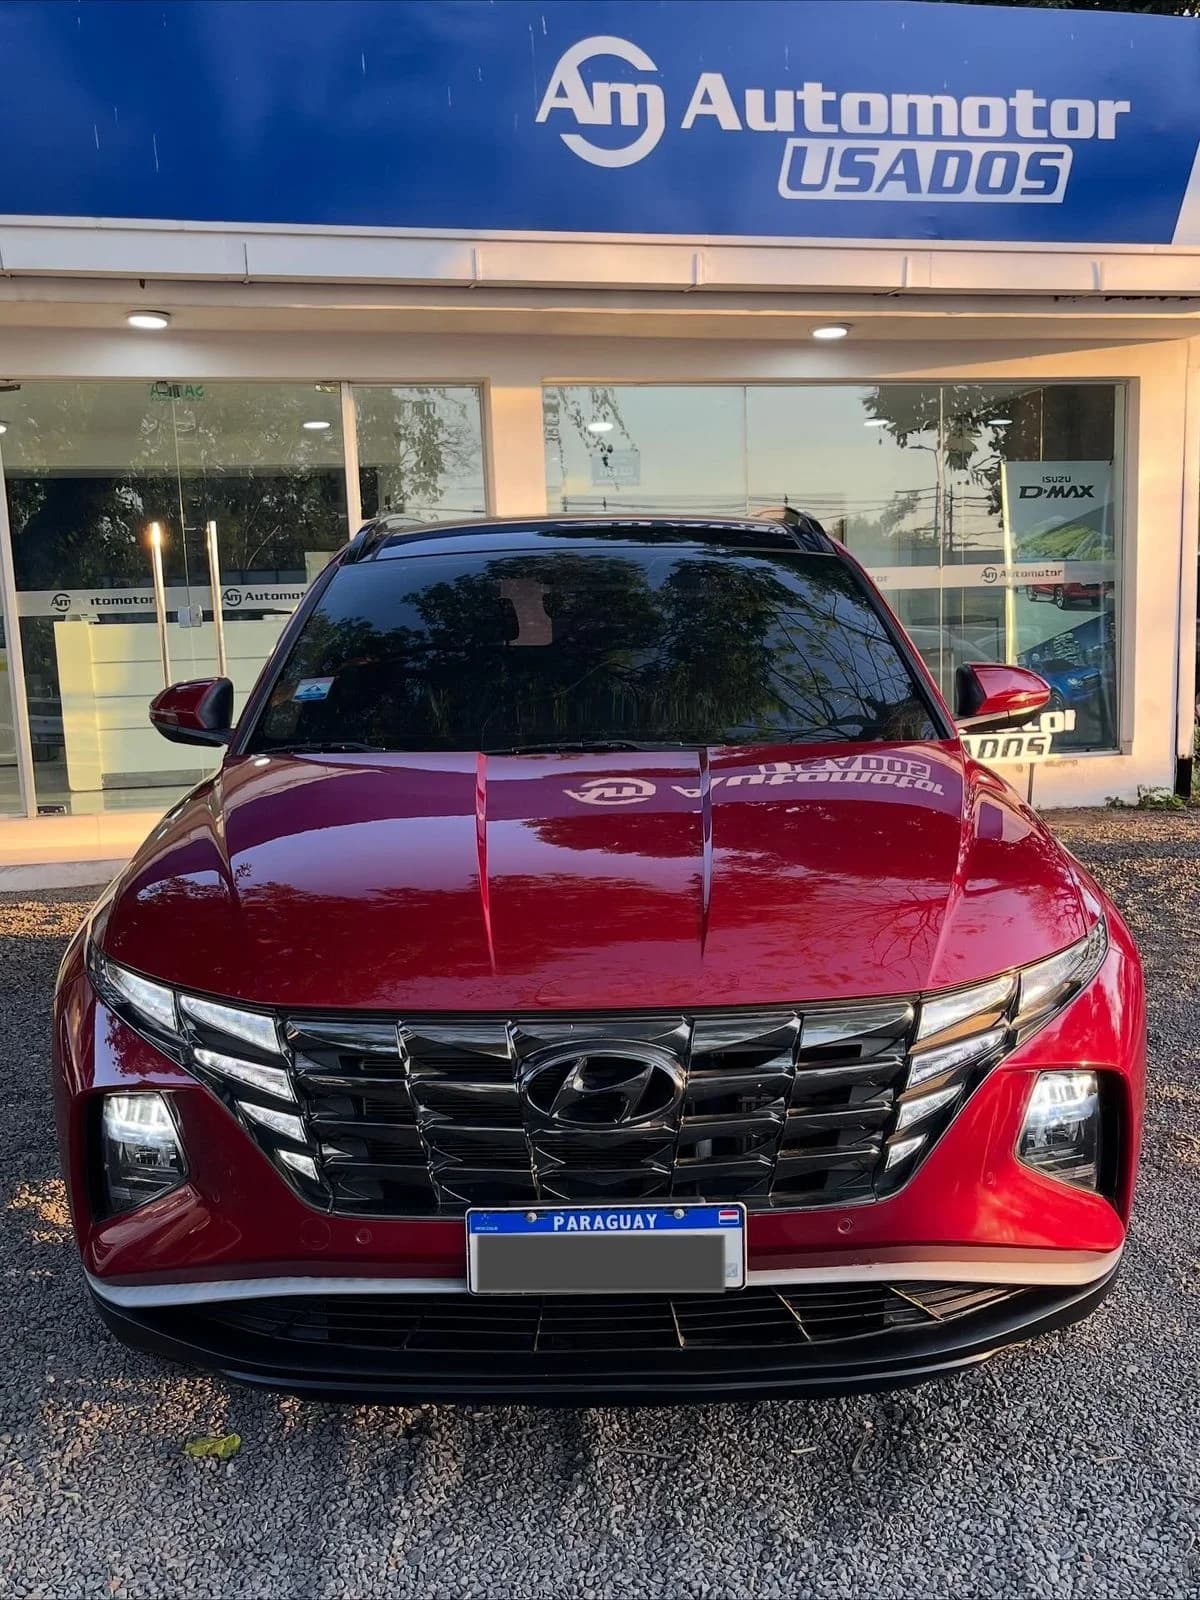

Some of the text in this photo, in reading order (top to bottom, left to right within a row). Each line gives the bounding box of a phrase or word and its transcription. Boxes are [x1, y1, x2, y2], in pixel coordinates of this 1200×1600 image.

[681, 72, 1131, 140] Automotor
[787, 145, 1064, 196] USADOS
[1042, 475, 1072, 483] ISUZU
[1000, 569, 1062, 578] Atomotor
[553, 1213, 658, 1232] PARAGUAY
